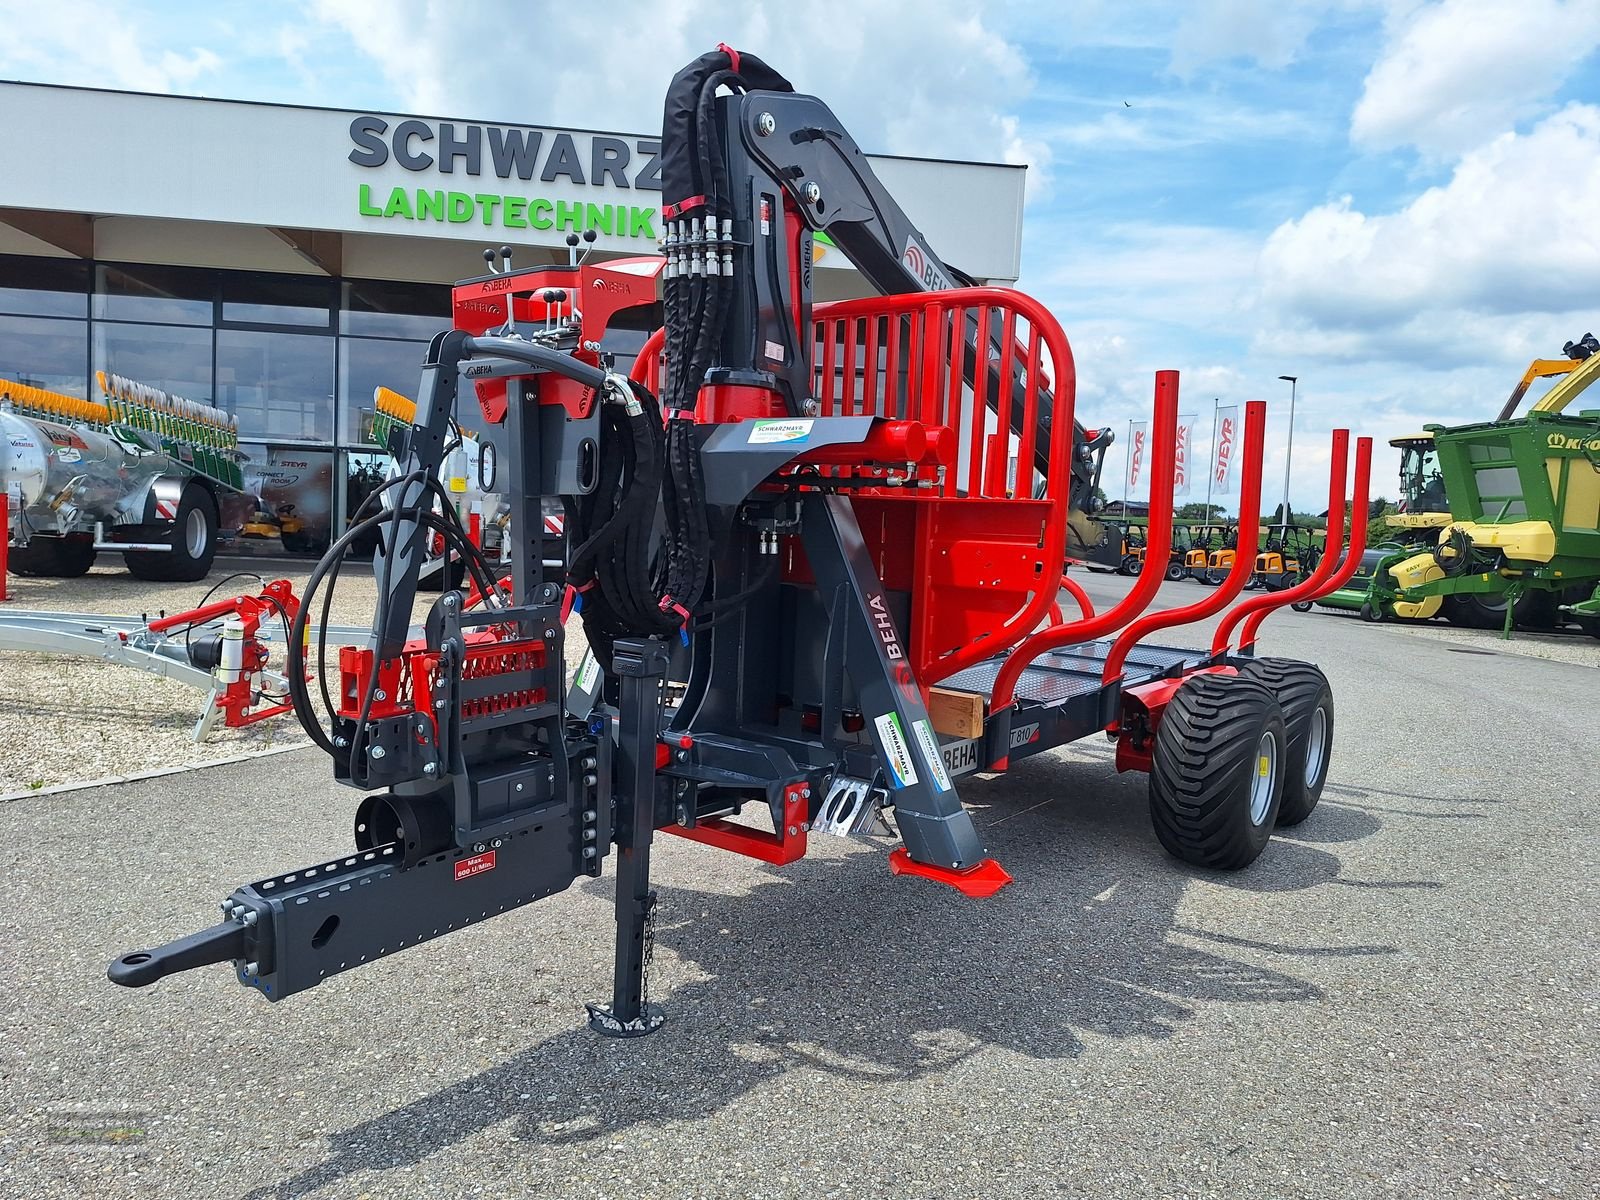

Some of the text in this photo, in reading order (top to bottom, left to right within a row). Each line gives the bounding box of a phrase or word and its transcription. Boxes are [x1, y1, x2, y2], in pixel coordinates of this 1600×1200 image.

[359, 184, 656, 239] LANDTECHNIK
[493, 279, 512, 292] BEHA
[924, 264, 947, 291] BE
[476, 365, 492, 374] BEHA
[1131, 431, 1144, 486] STEYR
[1174, 425, 1187, 486] STEYR
[1216, 418, 1232, 483] STEYR
[1406, 564, 1420, 573] EASY
[869, 595, 902, 659] BEHA
[888, 720, 909, 775] SCHWARZMAYR
[1017, 727, 1030, 743] 810
[922, 726, 945, 780] SCHWARZMAYR
[943, 742, 977, 771] BEHA
[457, 868, 471, 877] 600
[467, 857, 484, 866] Max.
